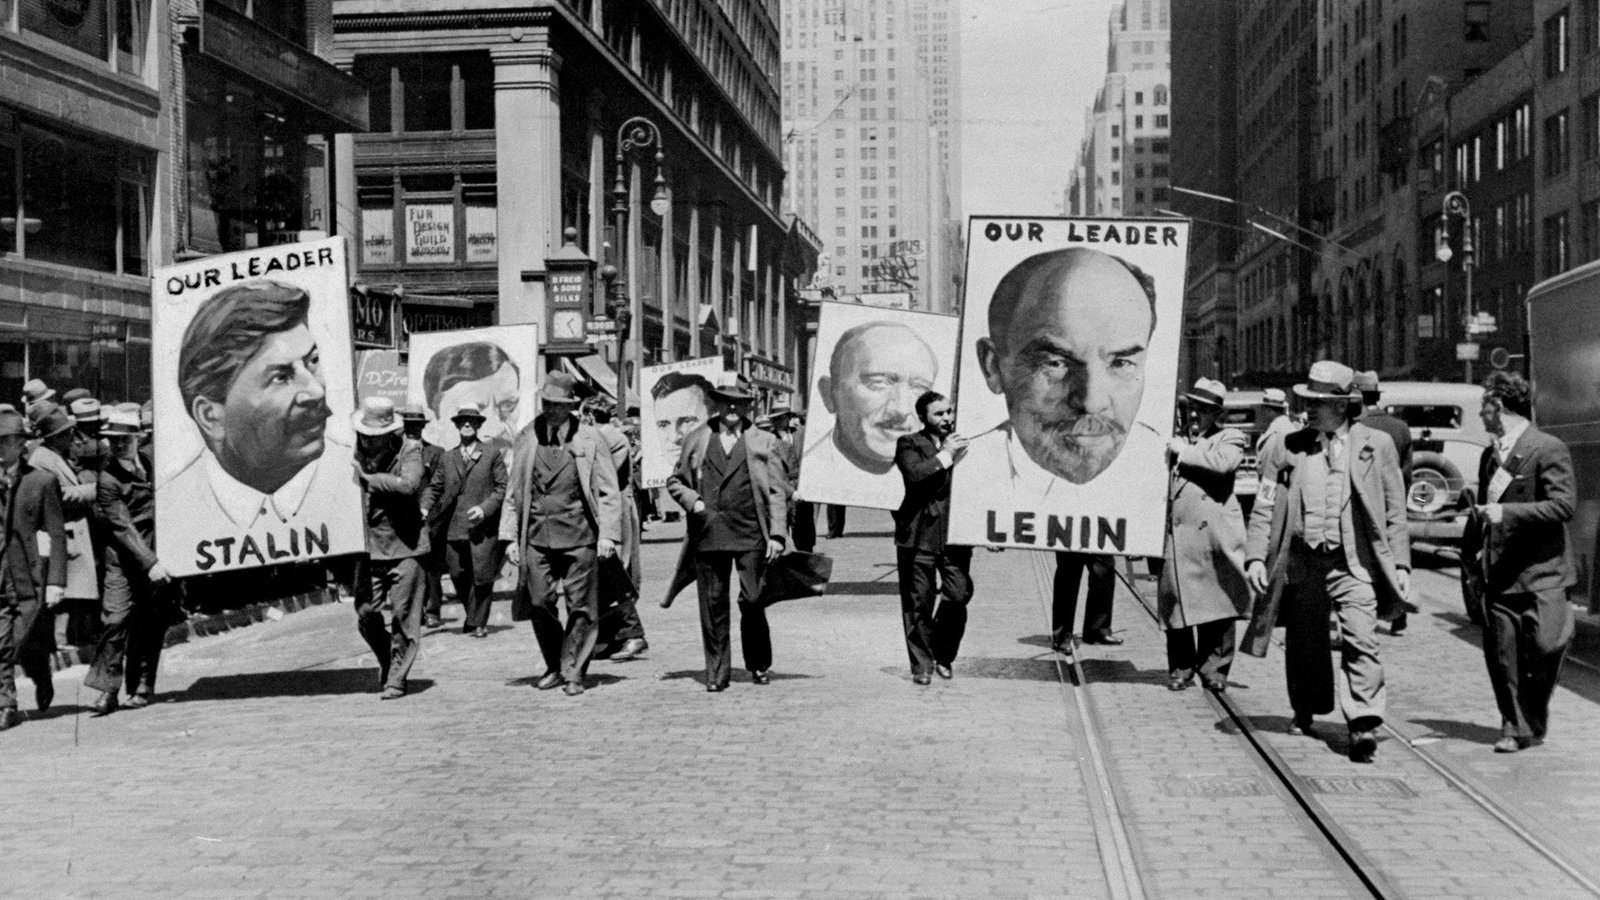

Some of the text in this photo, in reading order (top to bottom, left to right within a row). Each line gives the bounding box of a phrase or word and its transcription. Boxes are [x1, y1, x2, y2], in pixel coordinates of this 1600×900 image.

[410, 208, 433, 221] FUR
[413, 221, 450, 235] DESIGN
[984, 222, 1178, 247] OUR LEADER
[415, 234, 447, 247] GUILD
[167, 248, 333, 295] OUR LEADER
[560, 284, 582, 292] SONS
[554, 294, 580, 302] SILKS
[652, 359, 714, 373] OUR LEADER
[647, 478, 666, 486] CHA
[987, 510, 1127, 552] LENIN
[195, 522, 330, 571] STALIN
